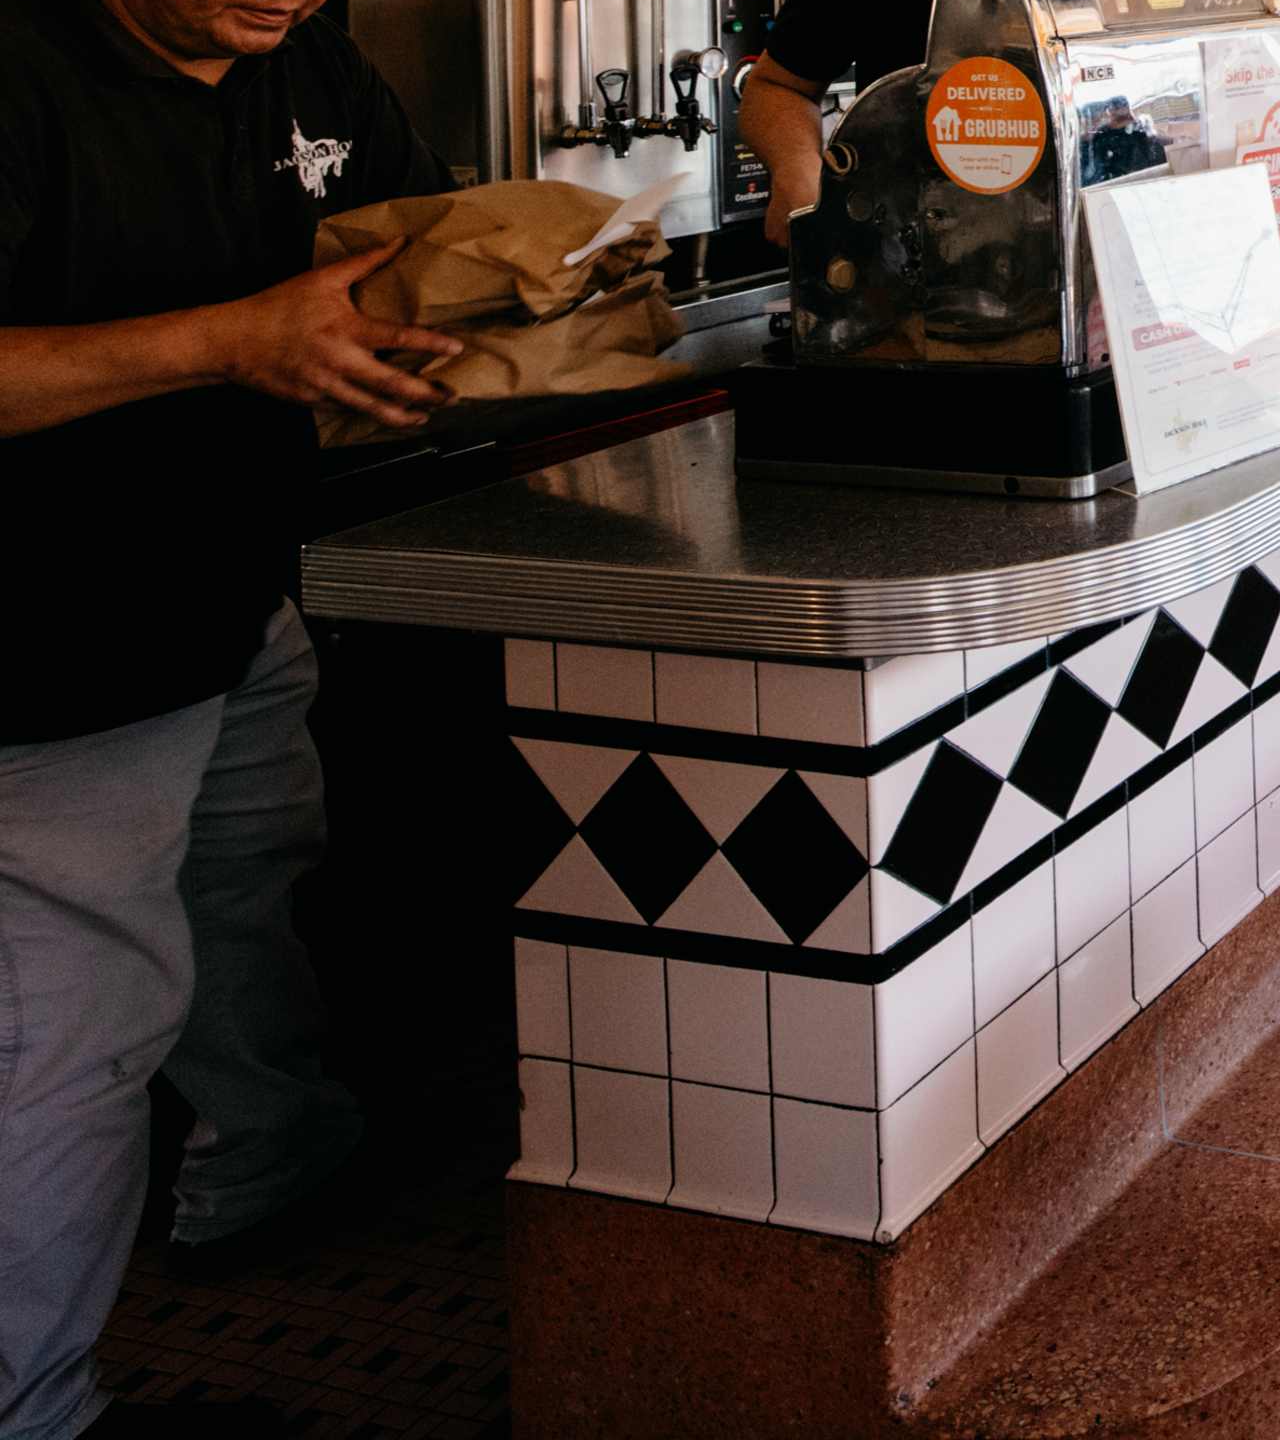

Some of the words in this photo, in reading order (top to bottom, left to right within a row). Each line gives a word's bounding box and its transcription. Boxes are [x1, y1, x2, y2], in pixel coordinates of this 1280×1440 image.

[1087, 66, 1115, 80] NCR
[946, 87, 1026, 101] DELIVERED
[964, 118, 1040, 139] GRUBHUB
